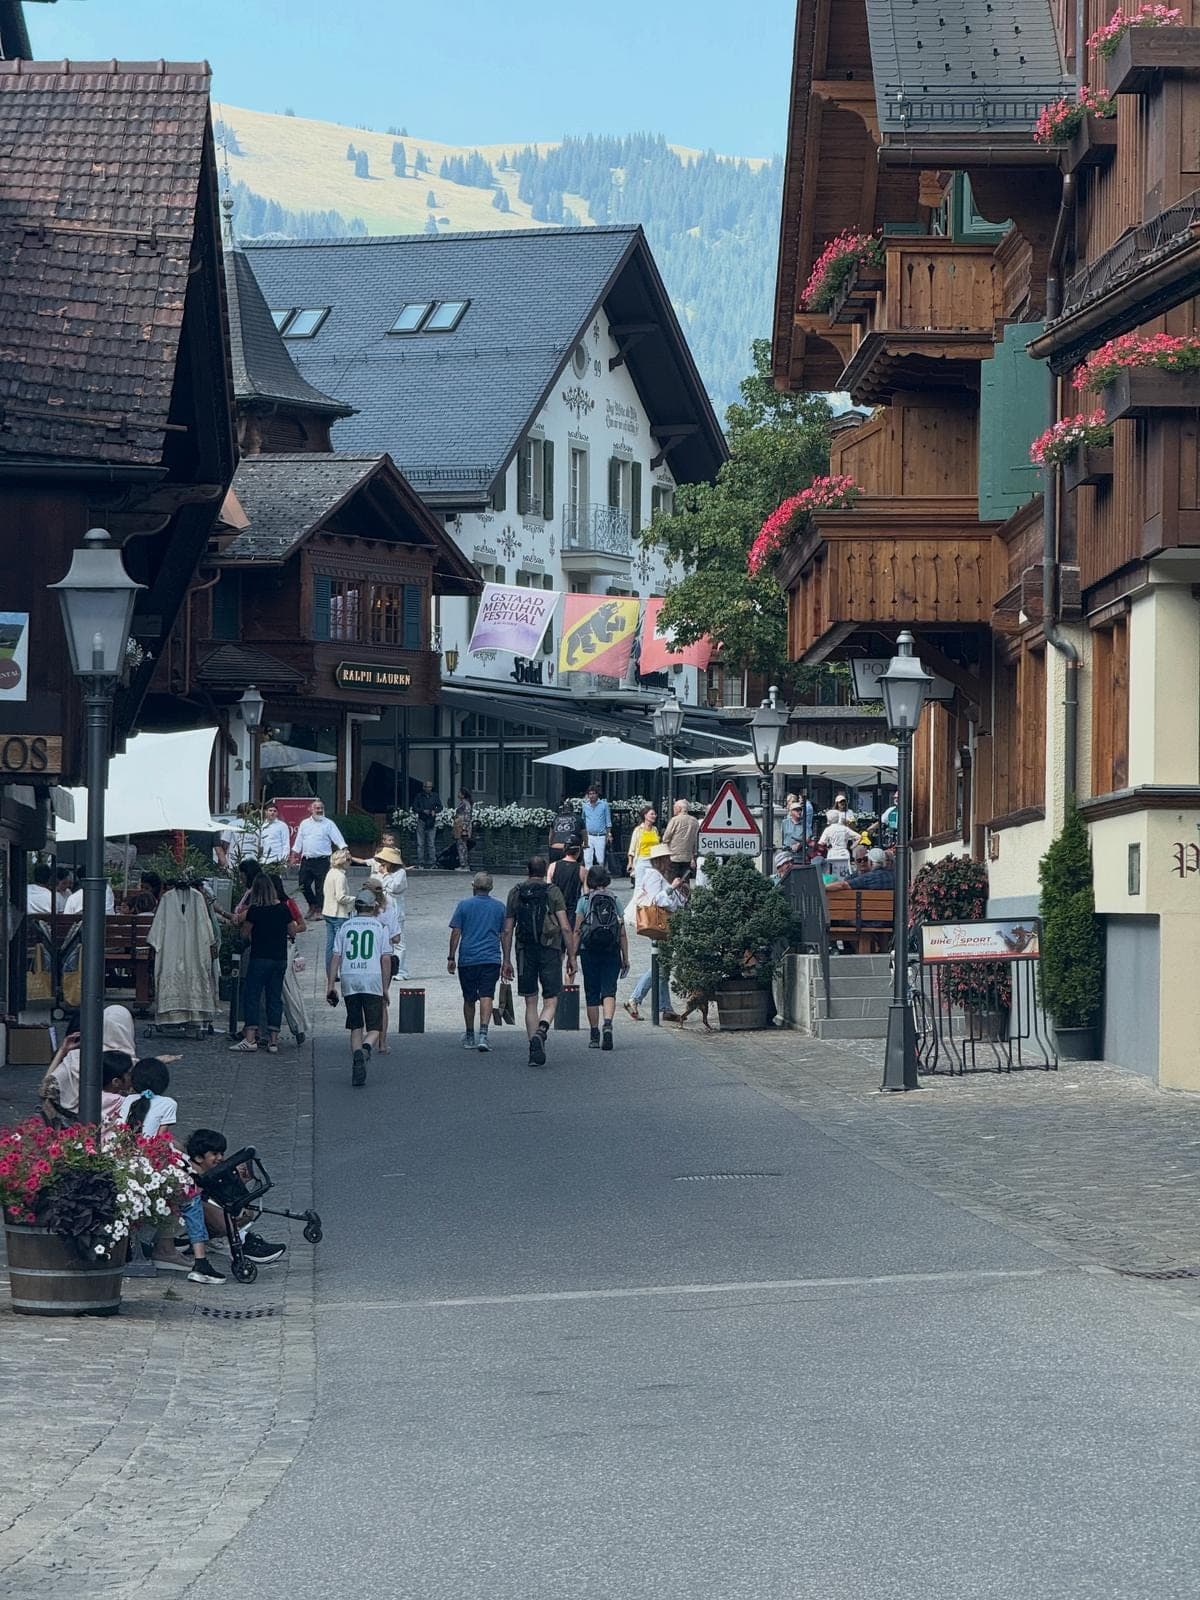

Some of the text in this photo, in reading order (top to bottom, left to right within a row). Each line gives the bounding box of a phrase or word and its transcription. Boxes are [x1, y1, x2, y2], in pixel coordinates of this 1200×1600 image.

[490, 593, 544, 606] GSTAAD
[483, 602, 546, 617] MENUHIN
[483, 611, 537, 626] FESTIVAL
[862, 663, 891, 675] POS
[343, 669, 411, 685] RALPH LAUREN
[0, 736, 48, 771] OS
[701, 837, 756, 849] Senksäulen
[346, 929, 374, 960] 30
[960, 936, 992, 944] SPORT
